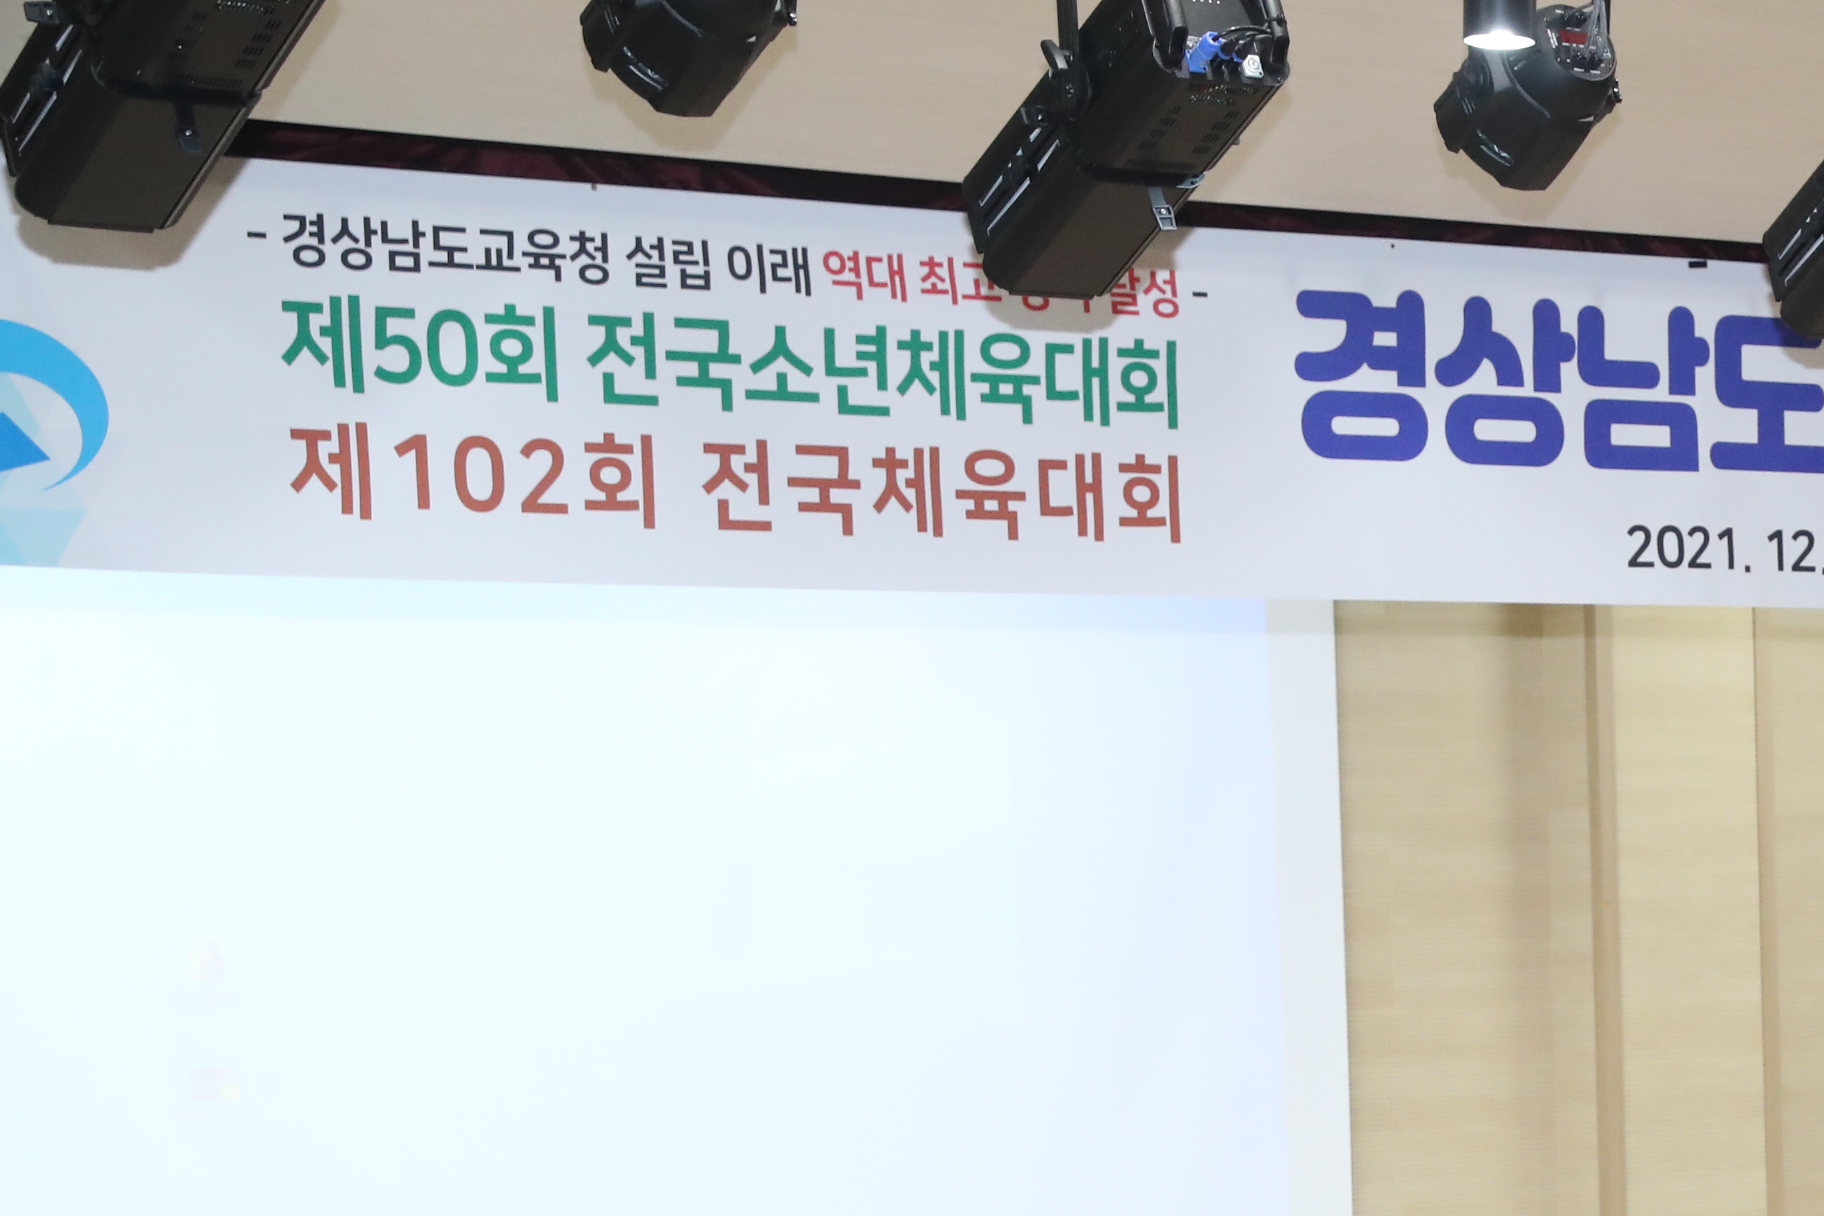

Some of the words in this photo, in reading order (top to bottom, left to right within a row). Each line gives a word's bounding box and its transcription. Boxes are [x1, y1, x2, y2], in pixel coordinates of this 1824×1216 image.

[283, 213, 609, 285] 경상남도교육청
[626, 236, 710, 290] 설립
[728, 244, 811, 296] 이래
[823, 251, 907, 302] 역대
[919, 255, 1002, 305] 최고
[281, 295, 558, 402] 제50회
[587, 308, 1179, 429] 전국소년체육대회
[290, 423, 654, 528] 제102회
[703, 440, 1180, 543] 전국체육대회
[1627, 525, 1750, 572] 2021.
